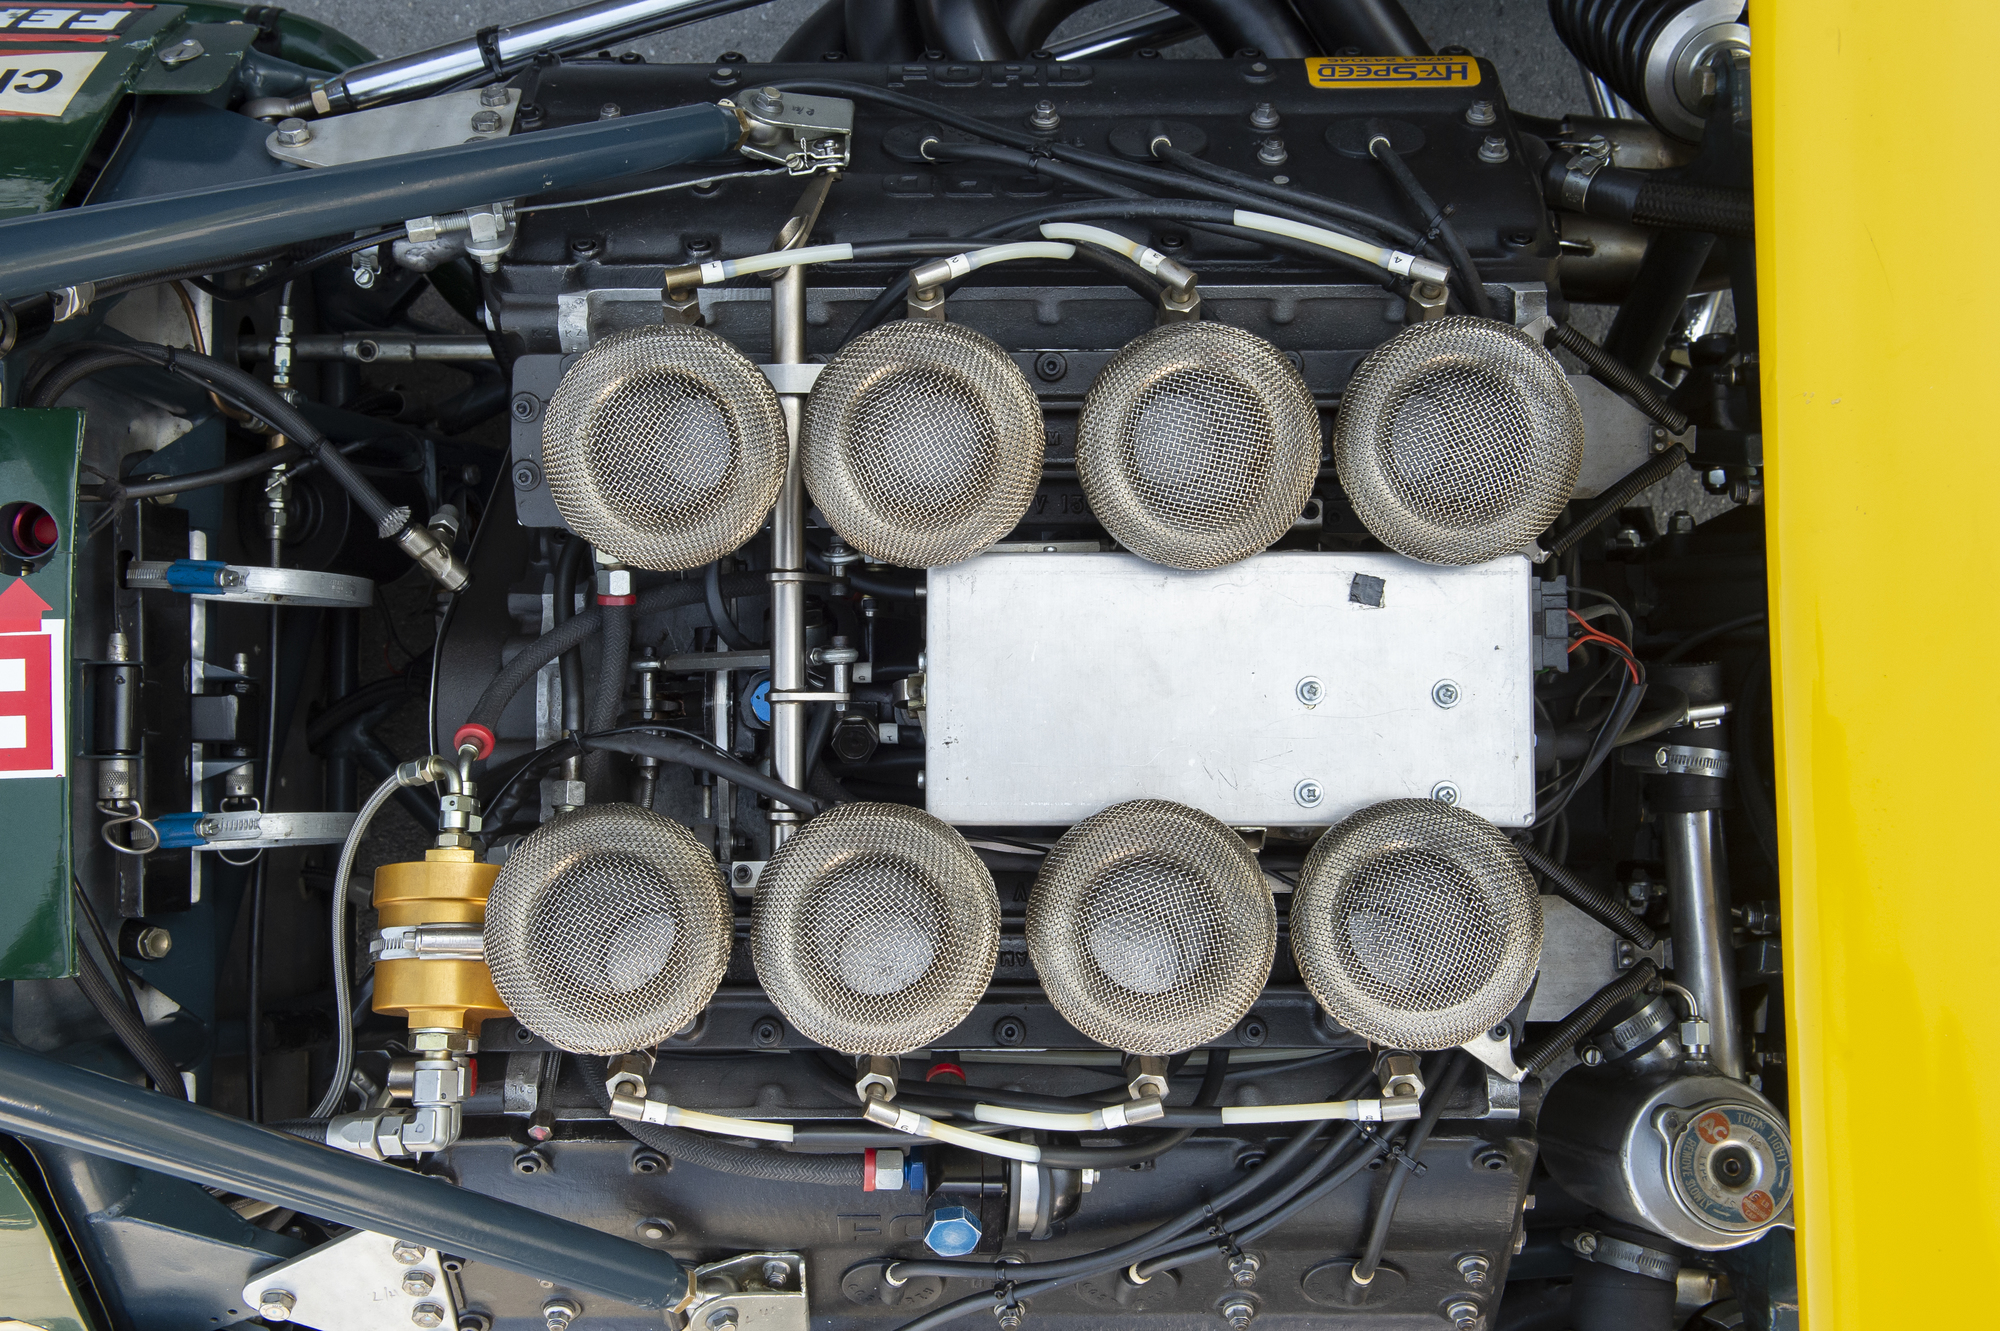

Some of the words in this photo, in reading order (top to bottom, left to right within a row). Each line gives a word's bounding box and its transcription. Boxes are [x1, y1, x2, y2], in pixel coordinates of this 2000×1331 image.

[887, 64, 1093, 88] FORD
[1394, 256, 1403, 264] 4
[1700, 1117, 1728, 1141] AC
[1736, 1112, 1766, 1130] TURN
[1767, 1131, 1789, 1163] TIGHT
[1681, 1137, 1697, 1178] REMOVE
[1699, 1155, 1709, 1183] TYPE
[1685, 1178, 1713, 1211] SLOWLY
[837, 1214, 926, 1241] FO
[1745, 1209, 1757, 1221] CAP
